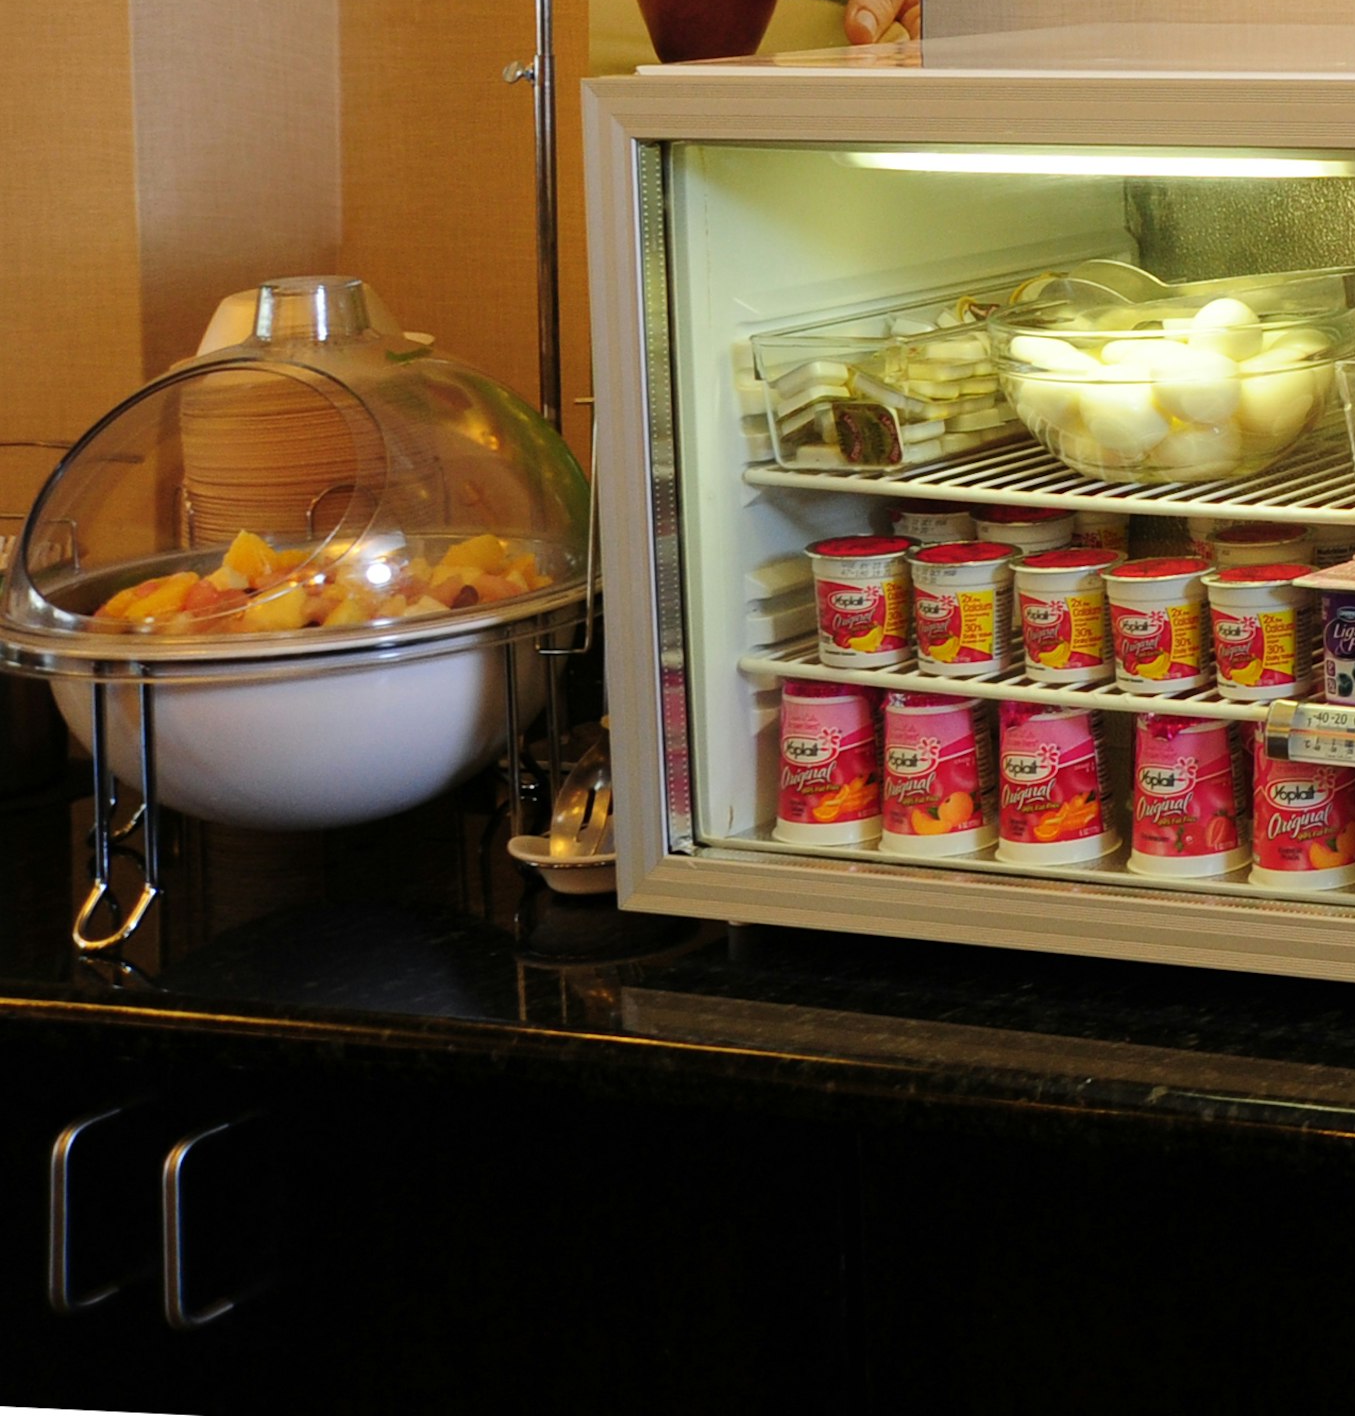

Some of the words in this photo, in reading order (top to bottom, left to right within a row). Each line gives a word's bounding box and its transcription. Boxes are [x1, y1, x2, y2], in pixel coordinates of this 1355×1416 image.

[1331, 713, 1348, 725] -20
[786, 742, 820, 759] Yoplait
[888, 750, 920, 769] Yoplait
[781, 760, 837, 792] Original
[1005, 757, 1038, 777] Yoplait
[884, 771, 936, 803] Original
[1140, 770, 1176, 793] Yoplait
[1000, 778, 1056, 811] Original
[1273, 785, 1317, 805] Yoplait
[1137, 791, 1193, 824] Original
[1268, 801, 1333, 840] Original
